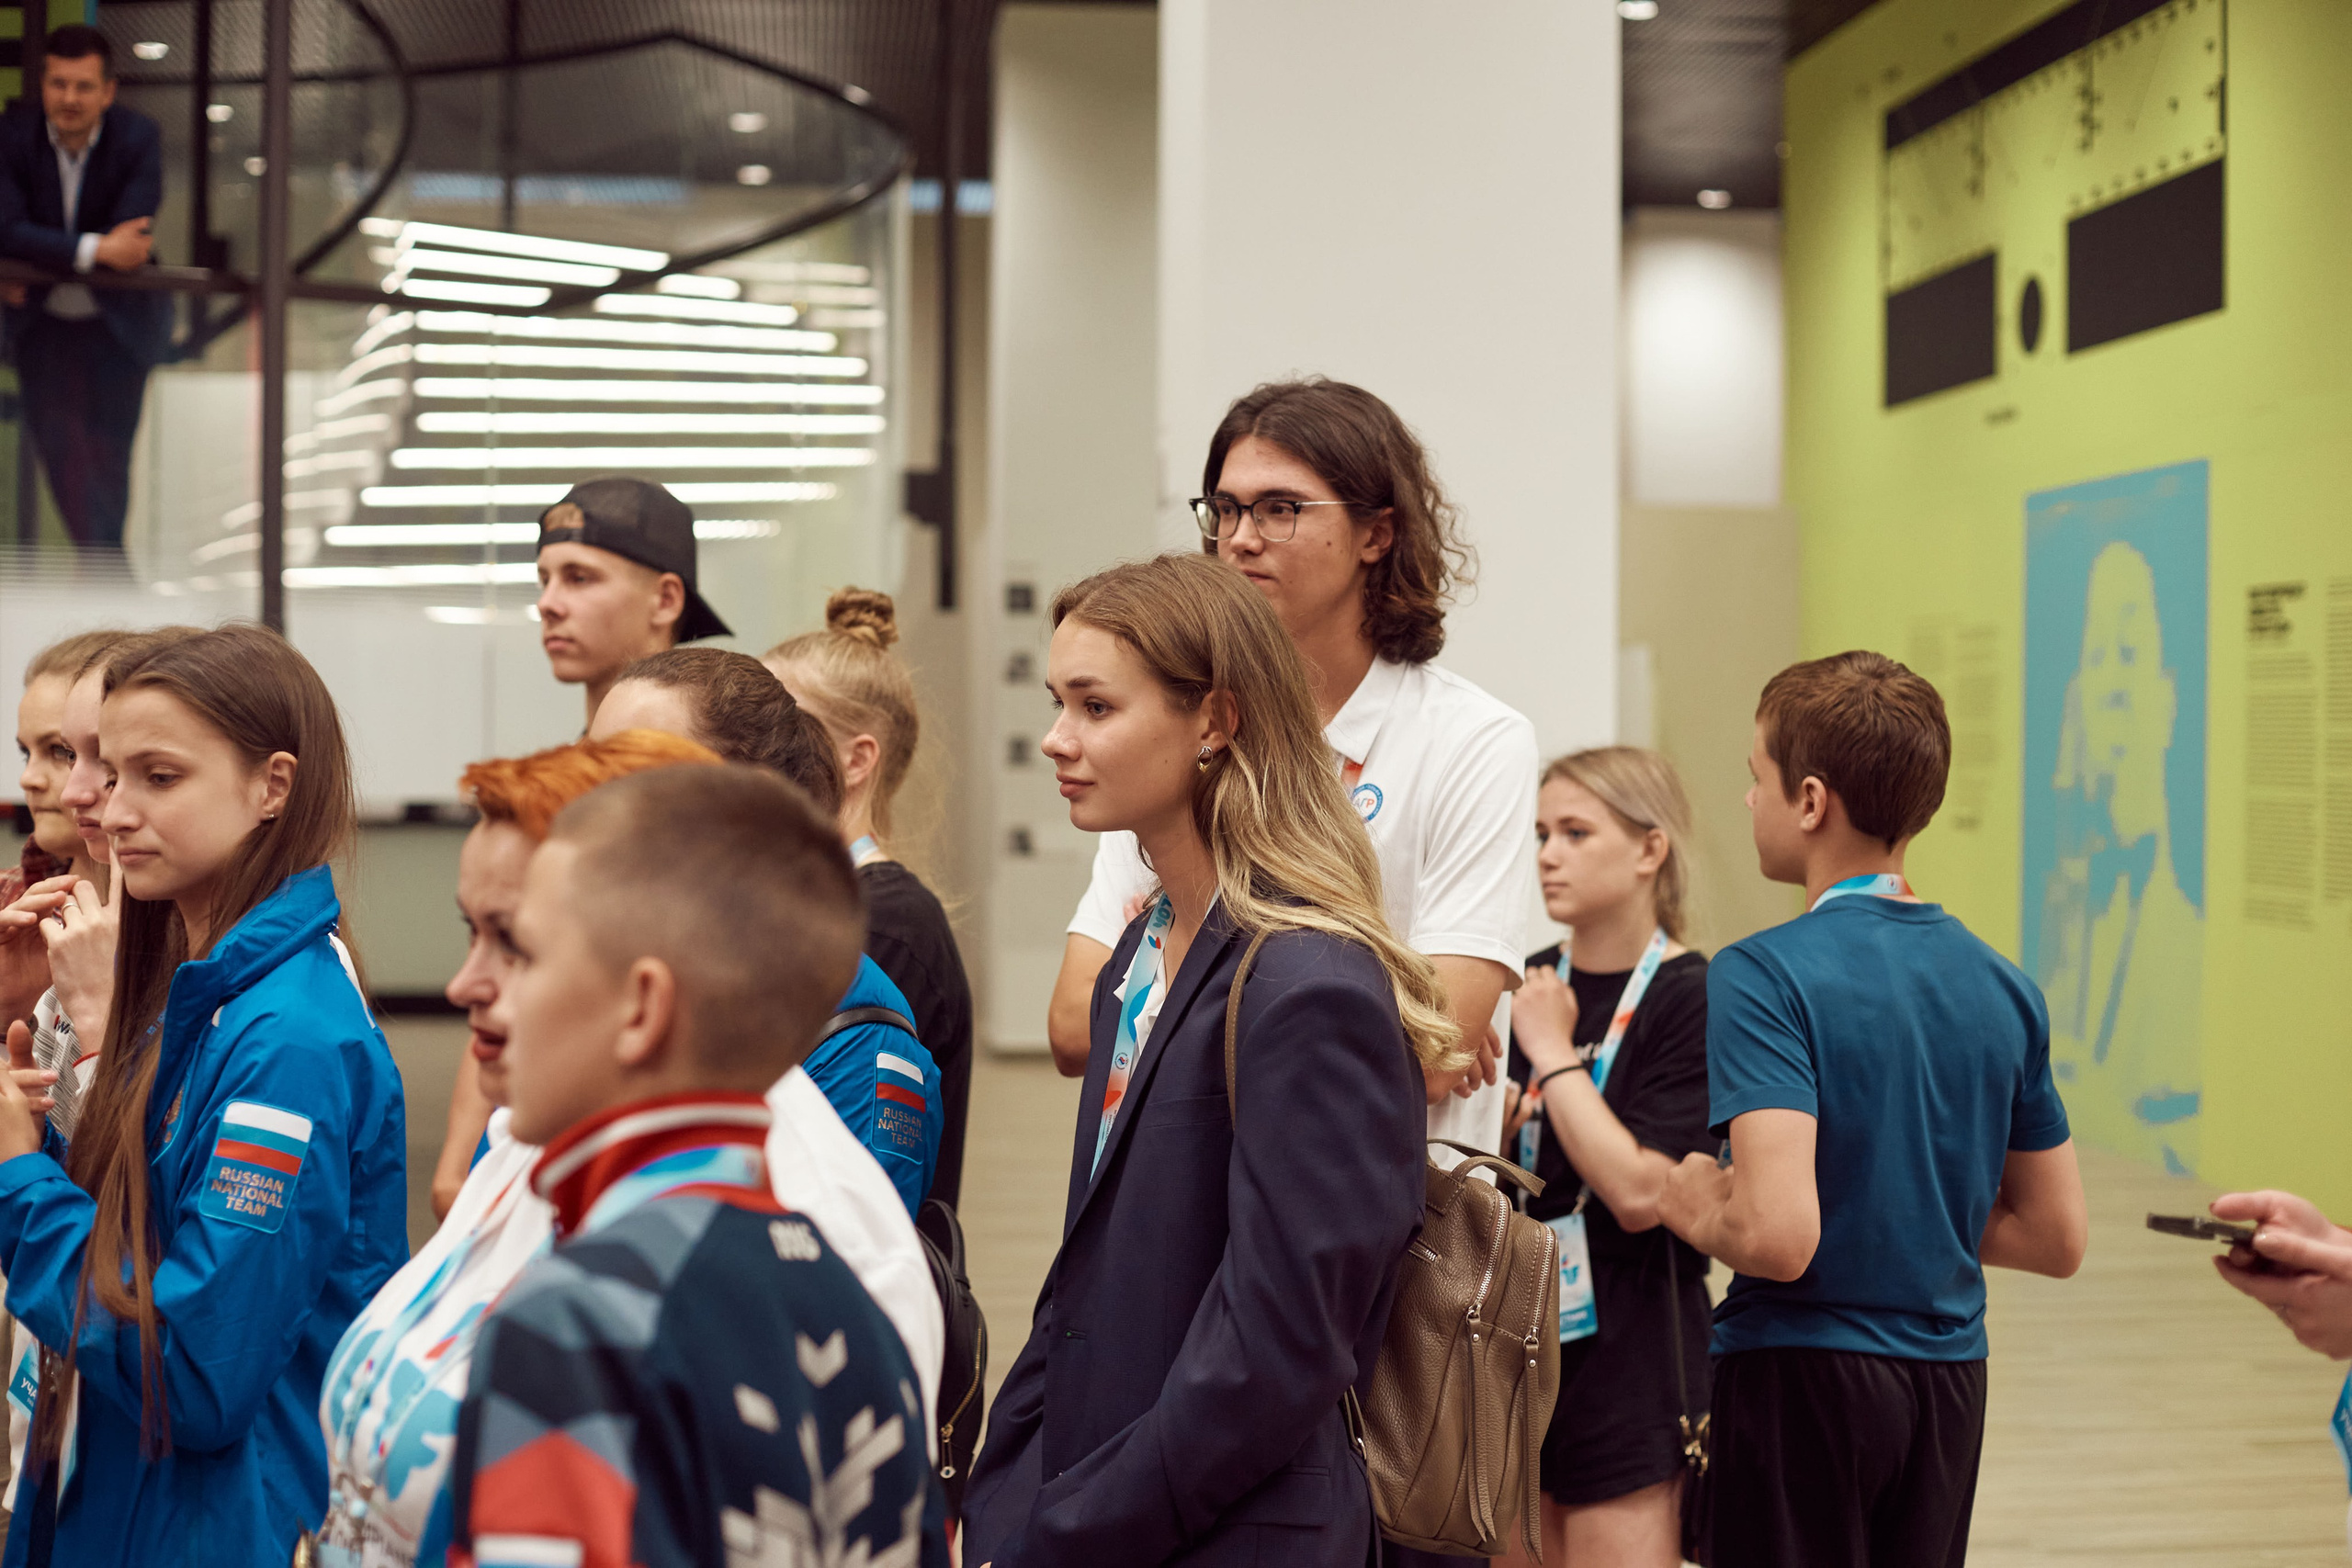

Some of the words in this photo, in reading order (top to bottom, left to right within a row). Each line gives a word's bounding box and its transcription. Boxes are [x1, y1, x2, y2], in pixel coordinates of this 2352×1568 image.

[884, 1107, 922, 1129] RUSSIAN
[878, 1118, 923, 1143] NATIONAL
[891, 1132, 916, 1148] TEAM
[219, 1166, 285, 1194] RUSSIAN
[210, 1179, 284, 1209] NATIONAL
[225, 1196, 267, 1218] TEAM
